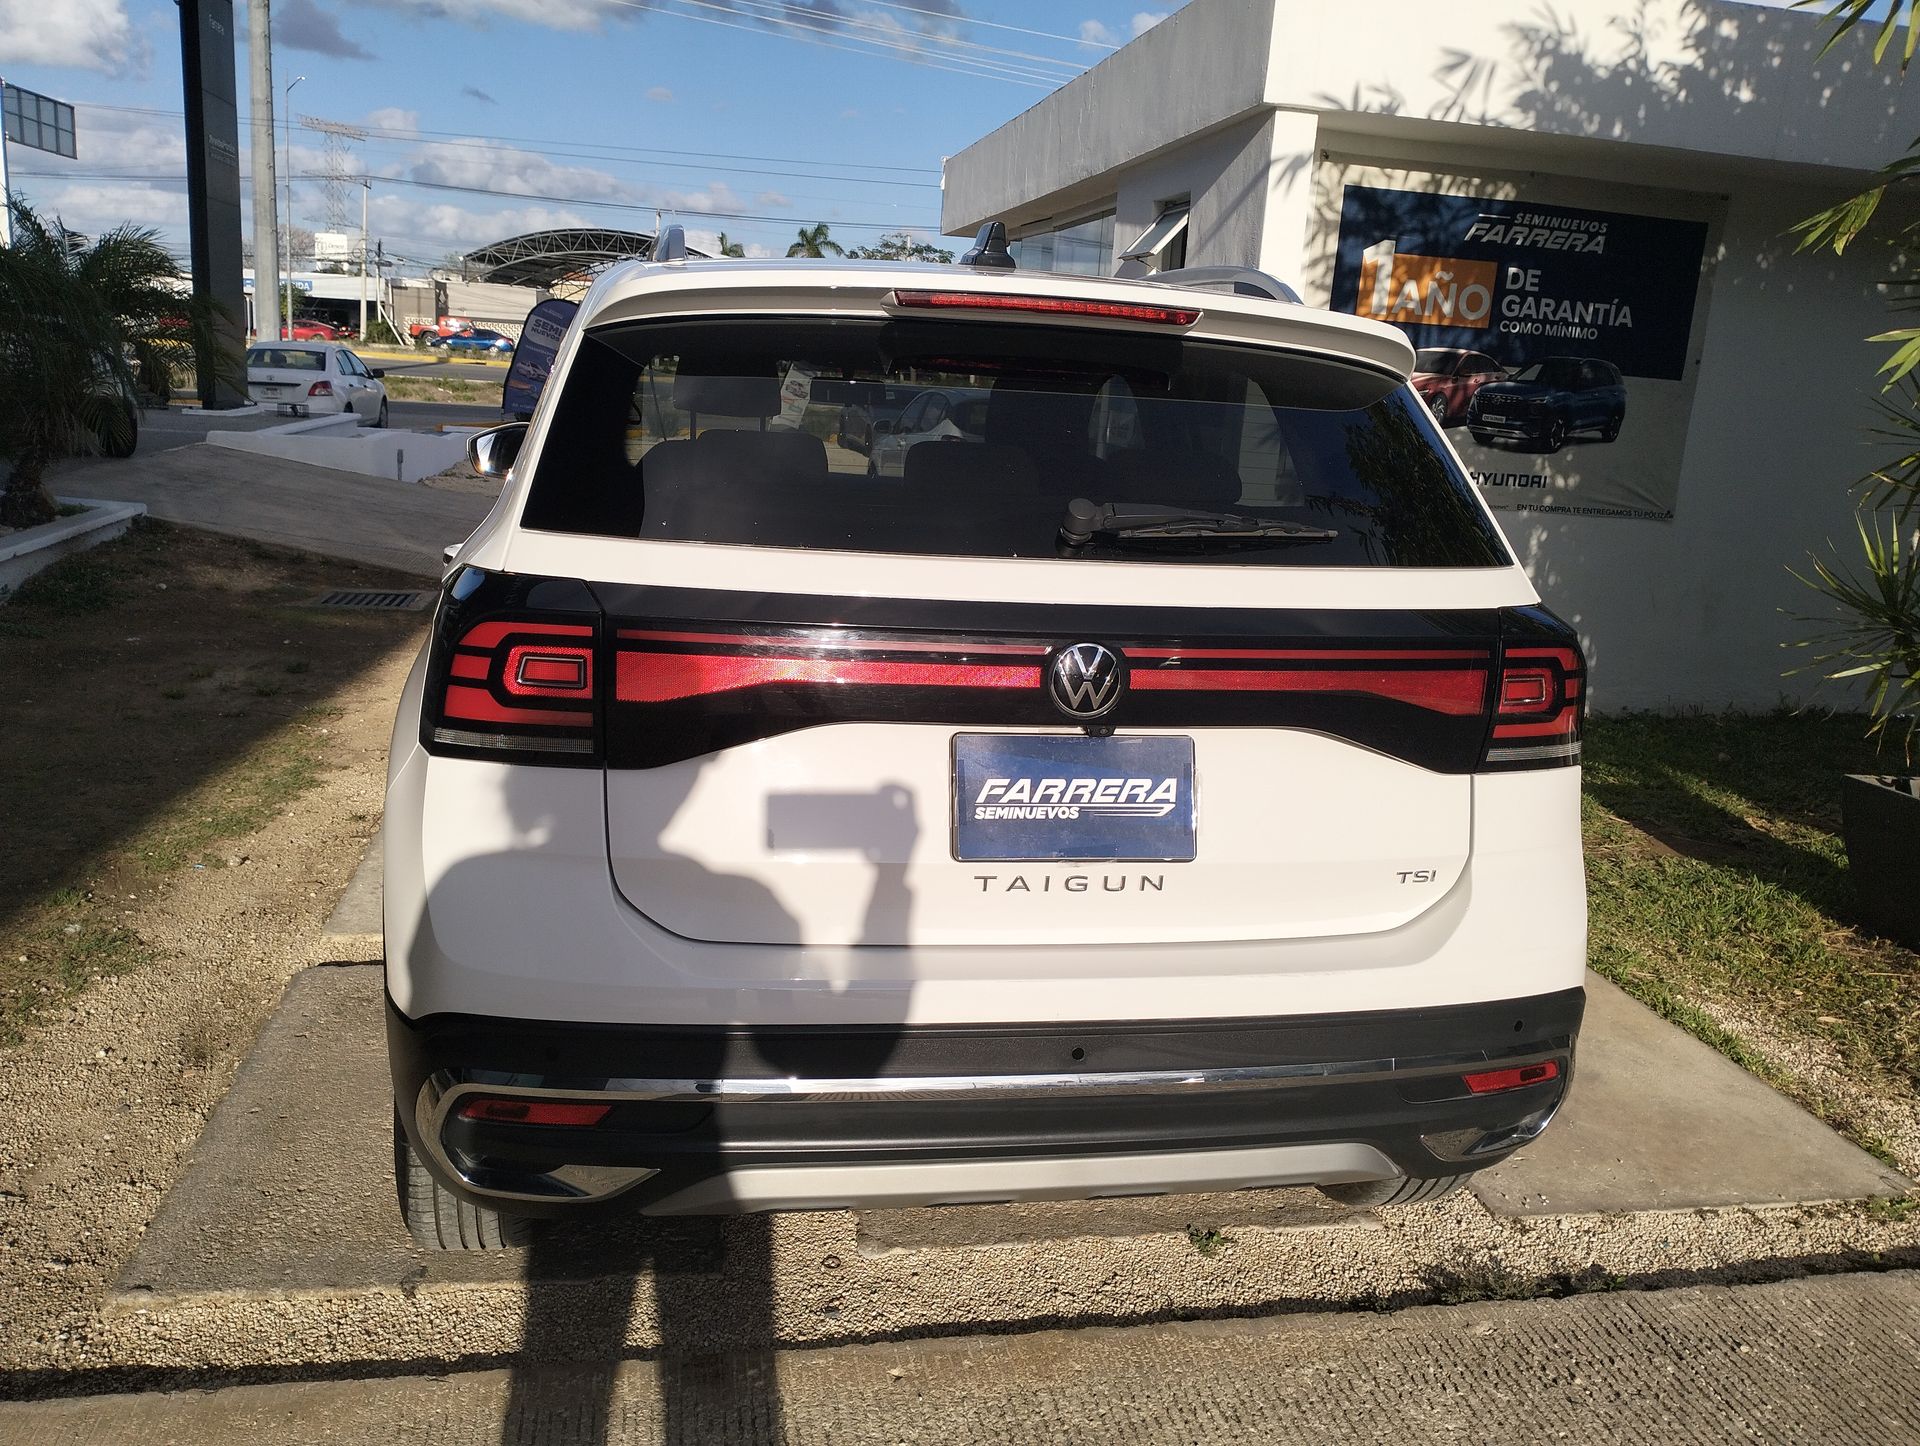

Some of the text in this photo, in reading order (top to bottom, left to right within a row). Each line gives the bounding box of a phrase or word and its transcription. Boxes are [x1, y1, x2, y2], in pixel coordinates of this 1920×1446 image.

[1514, 212, 1609, 234] SEMINUEVOS
[1463, 222, 1606, 255] FARRERA
[1506, 266, 1542, 292] DE
[1501, 294, 1633, 328] GARANTÍA
[531, 326, 560, 342] NUEVOS
[533, 318, 563, 337] SEMI
[1500, 320, 1598, 340] COMO MÍNIMO
[1470, 471, 1548, 489] HYUNDAI
[1528, 504, 1539, 512] TU
[1539, 505, 1572, 514] COMPRA
[1572, 506, 1581, 515] TE
[1582, 507, 1633, 517] ENTREGAMOS
[975, 778, 1178, 804] FARRERA
[974, 806, 1080, 820] SEMINUEVOS
[974, 875, 1164, 892] TAIGUN
[1396, 869, 1437, 884] TSI
